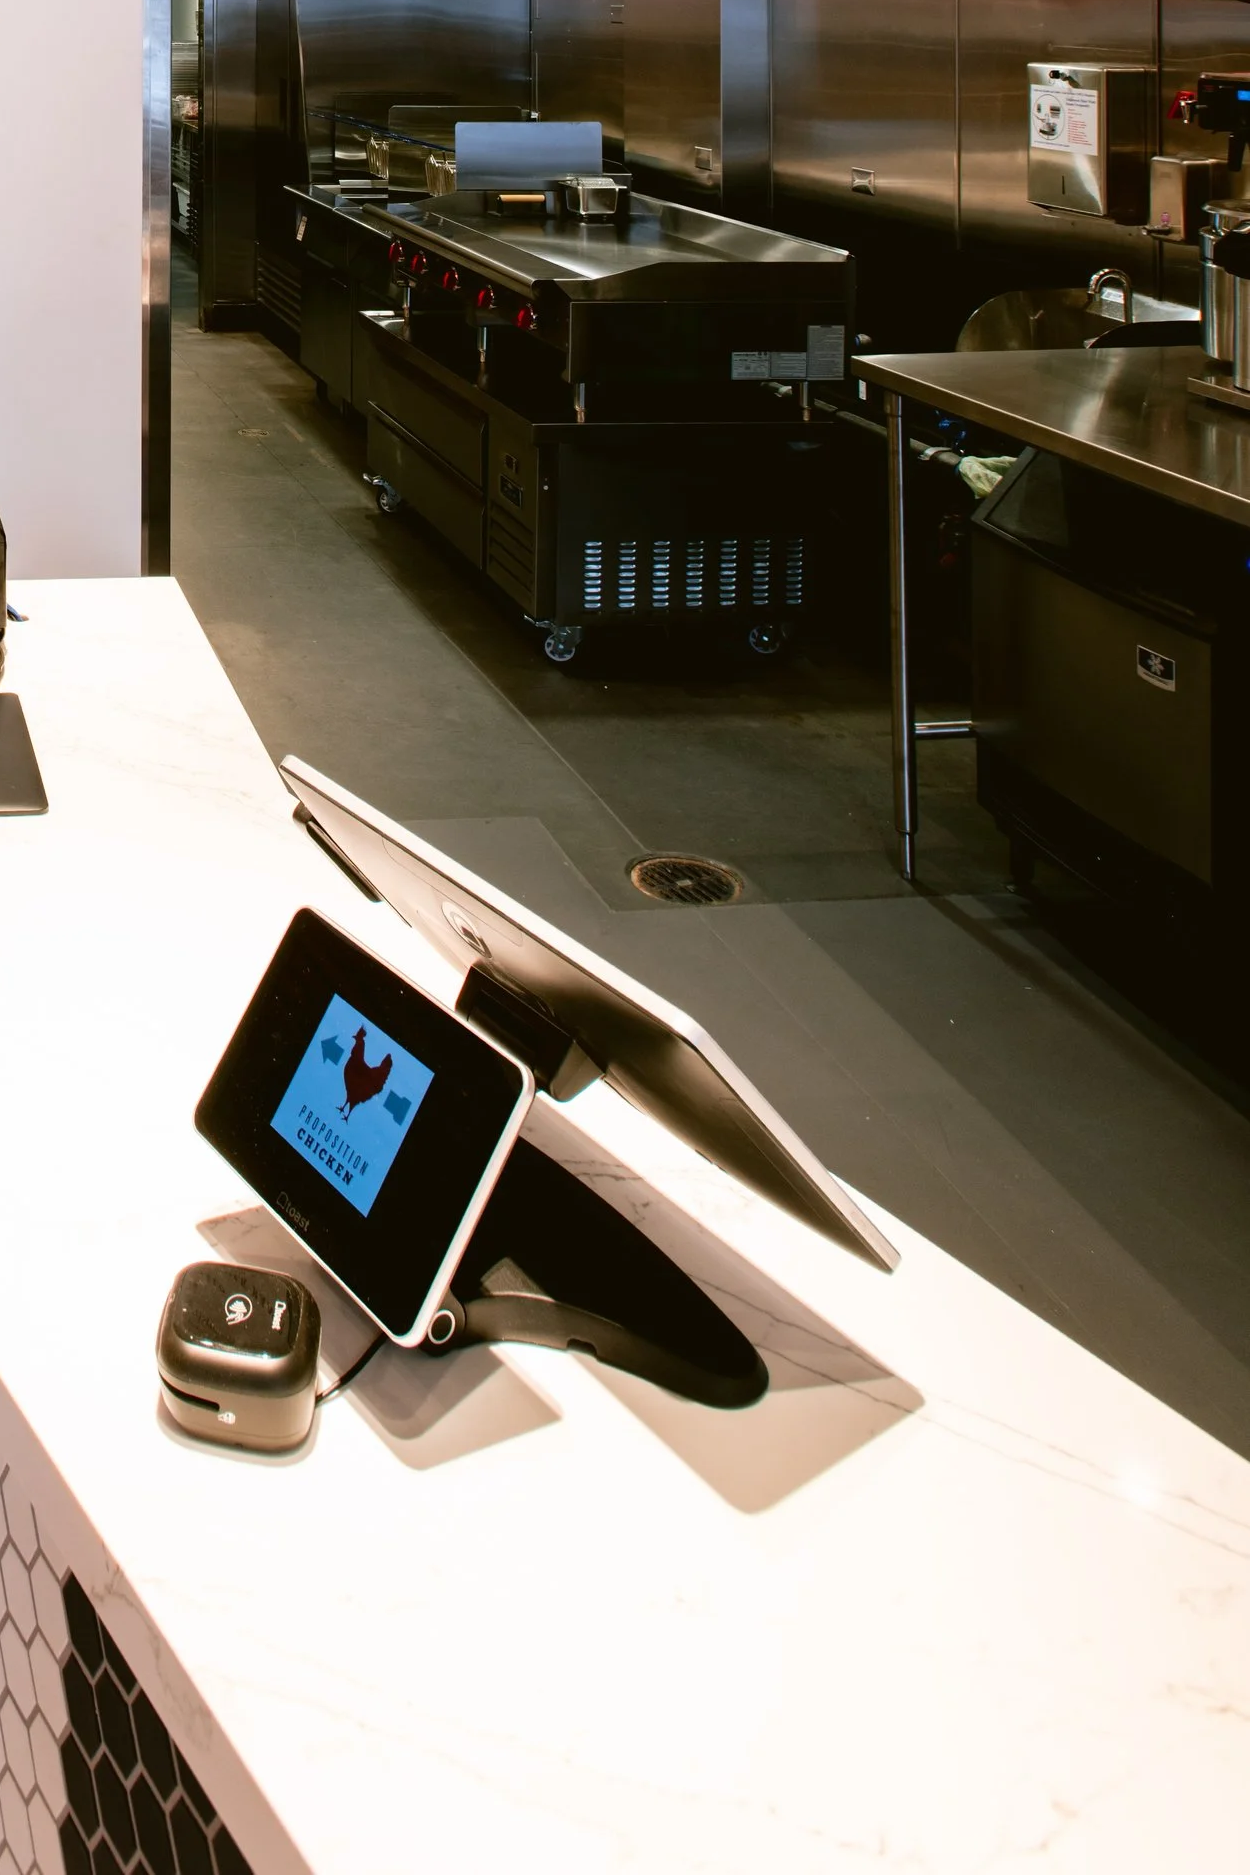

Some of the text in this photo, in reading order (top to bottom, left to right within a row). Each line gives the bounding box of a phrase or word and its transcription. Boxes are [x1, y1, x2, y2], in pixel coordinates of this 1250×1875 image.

[297, 1127, 354, 1185] CHICKEN
[298, 1104, 369, 1177] PROPOSITION
[285, 1201, 310, 1233] toast
